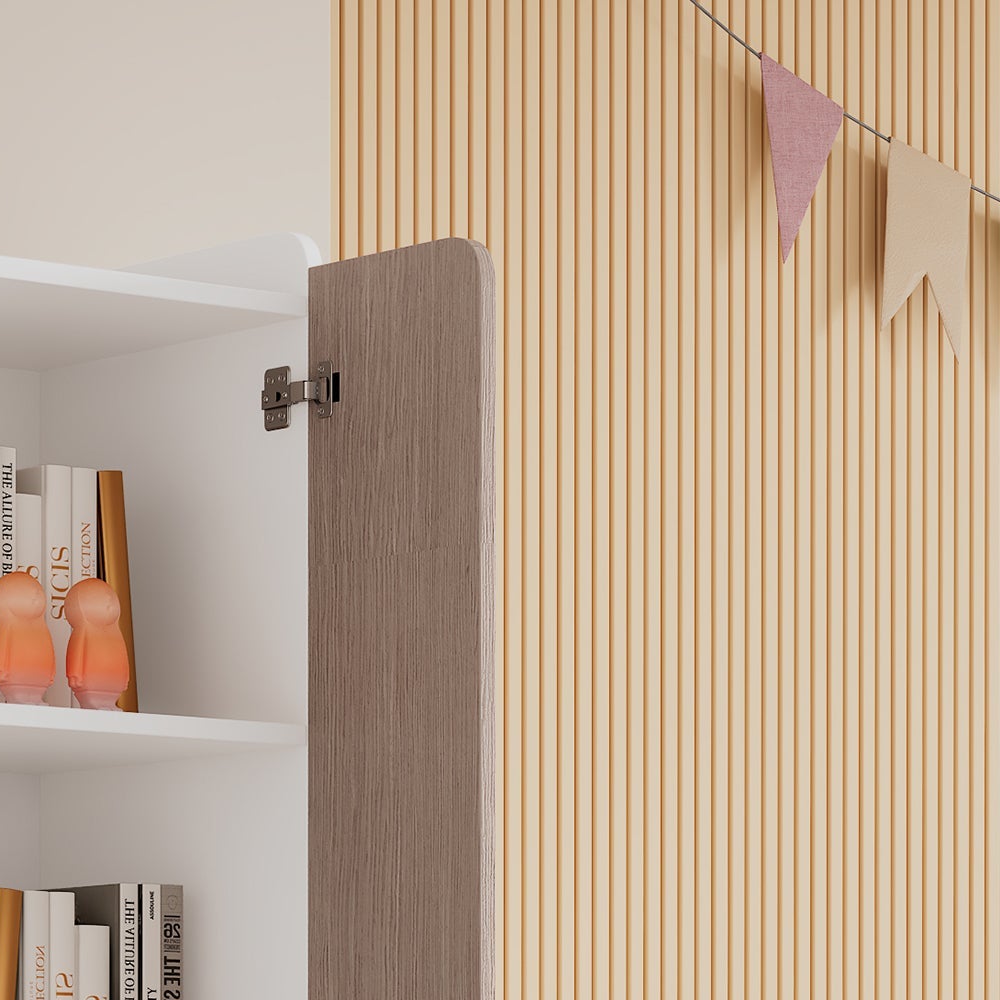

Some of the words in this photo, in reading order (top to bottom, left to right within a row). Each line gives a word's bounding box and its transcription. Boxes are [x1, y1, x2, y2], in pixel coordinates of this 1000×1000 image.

[2, 463, 13, 489] THE
[2, 491, 13, 541] ALLURE
[2, 543, 13, 560] OF
[81, 521, 92, 578] ECTION
[49, 546, 70, 620] SICIS
